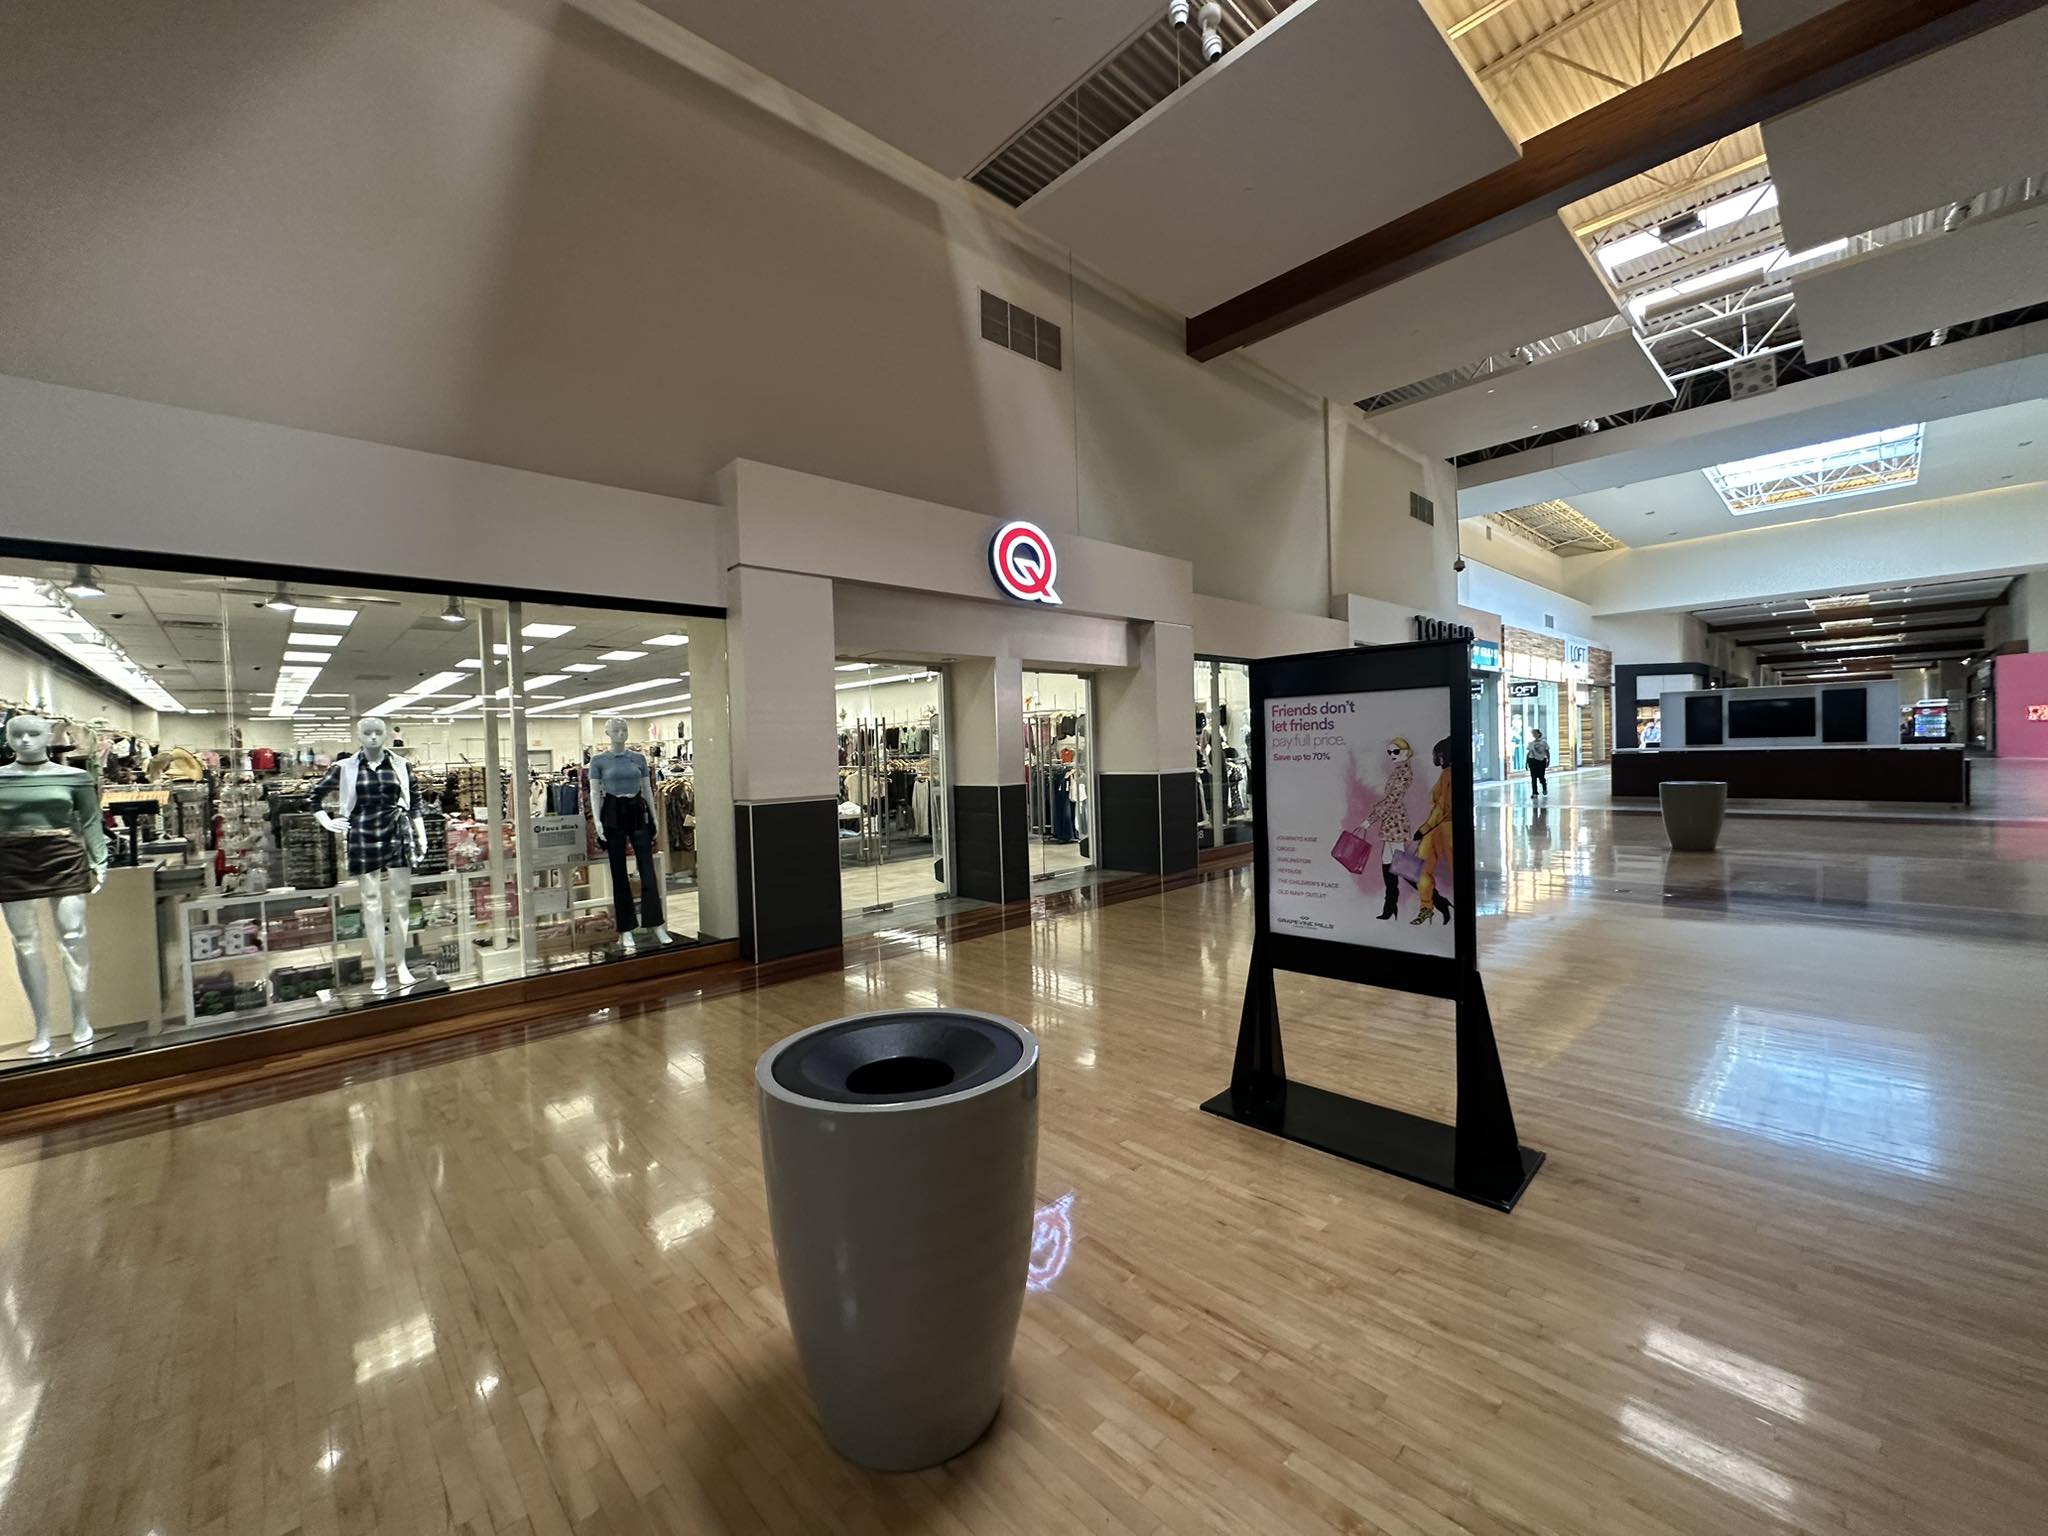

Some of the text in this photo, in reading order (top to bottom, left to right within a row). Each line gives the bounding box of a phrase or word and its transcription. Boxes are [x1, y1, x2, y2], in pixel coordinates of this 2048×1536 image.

[988, 520, 1063, 605] Q
[1570, 645, 1586, 661] LOFT
[1510, 685, 1536, 694] LOFT
[1271, 700, 1355, 717] Friends don't
[1271, 717, 1334, 732] let friends
[1272, 733, 1346, 749] pay full price.
[1273, 752, 1331, 762] Save up to 70%
